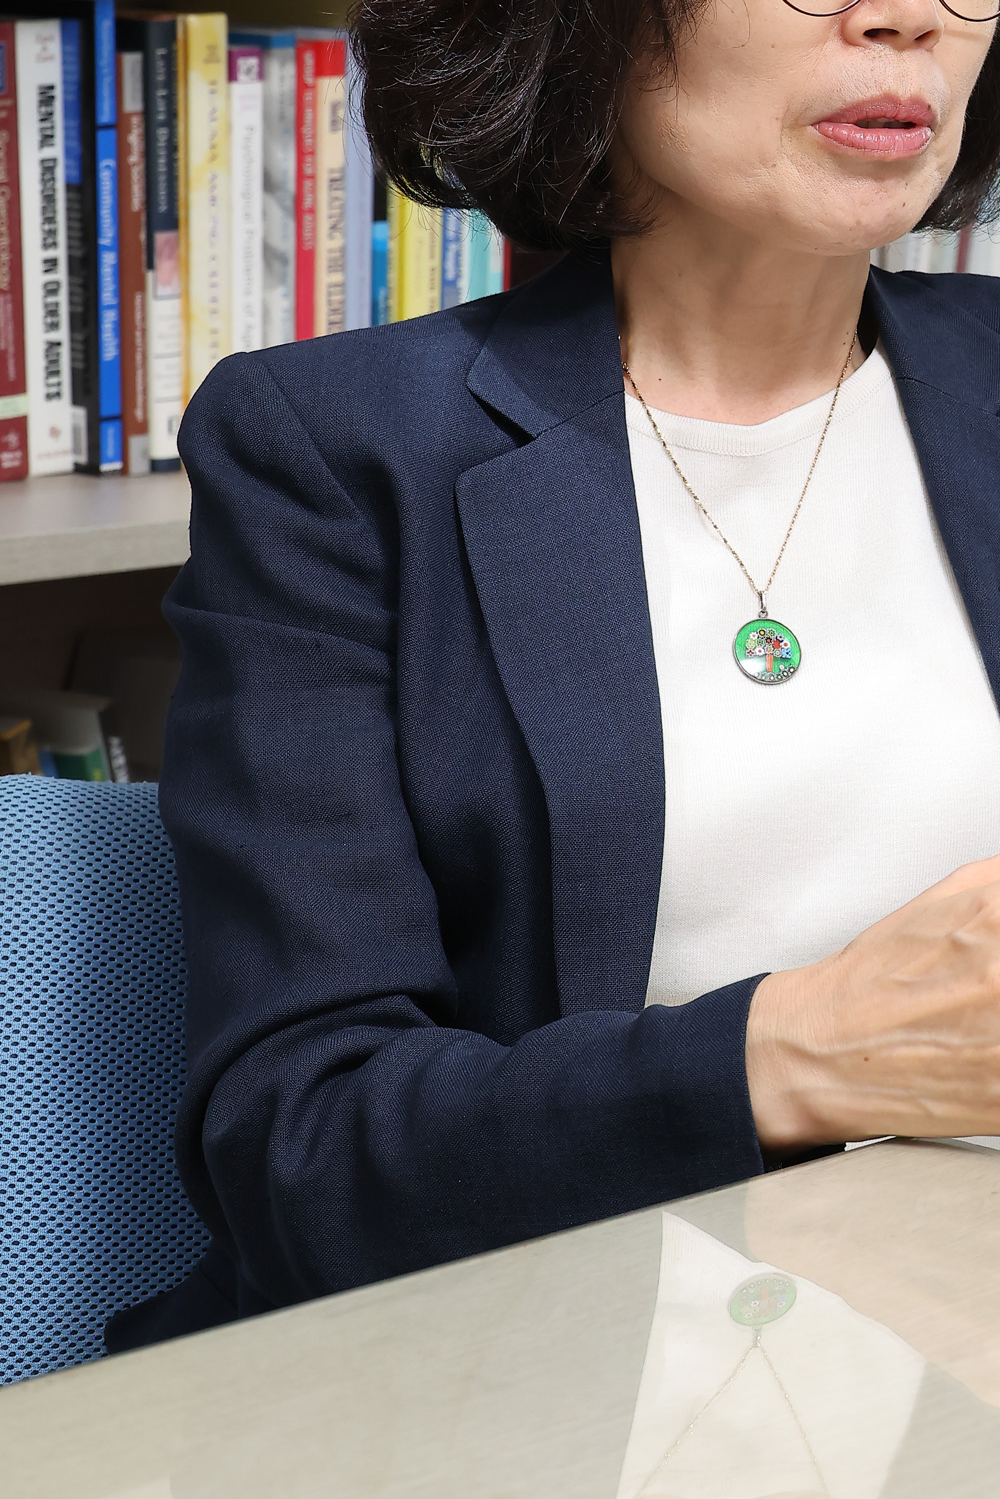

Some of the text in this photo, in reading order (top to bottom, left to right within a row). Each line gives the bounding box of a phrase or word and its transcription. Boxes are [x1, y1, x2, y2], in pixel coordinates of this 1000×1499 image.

[327, 166, 346, 241] TREATING
[38, 83, 63, 403] MENTAL DISORDERS IN OLDER ADULTS
[97, 157, 119, 362] Community Mental Health
[240, 320, 257, 352] Age
[327, 282, 346, 334] ELDER
